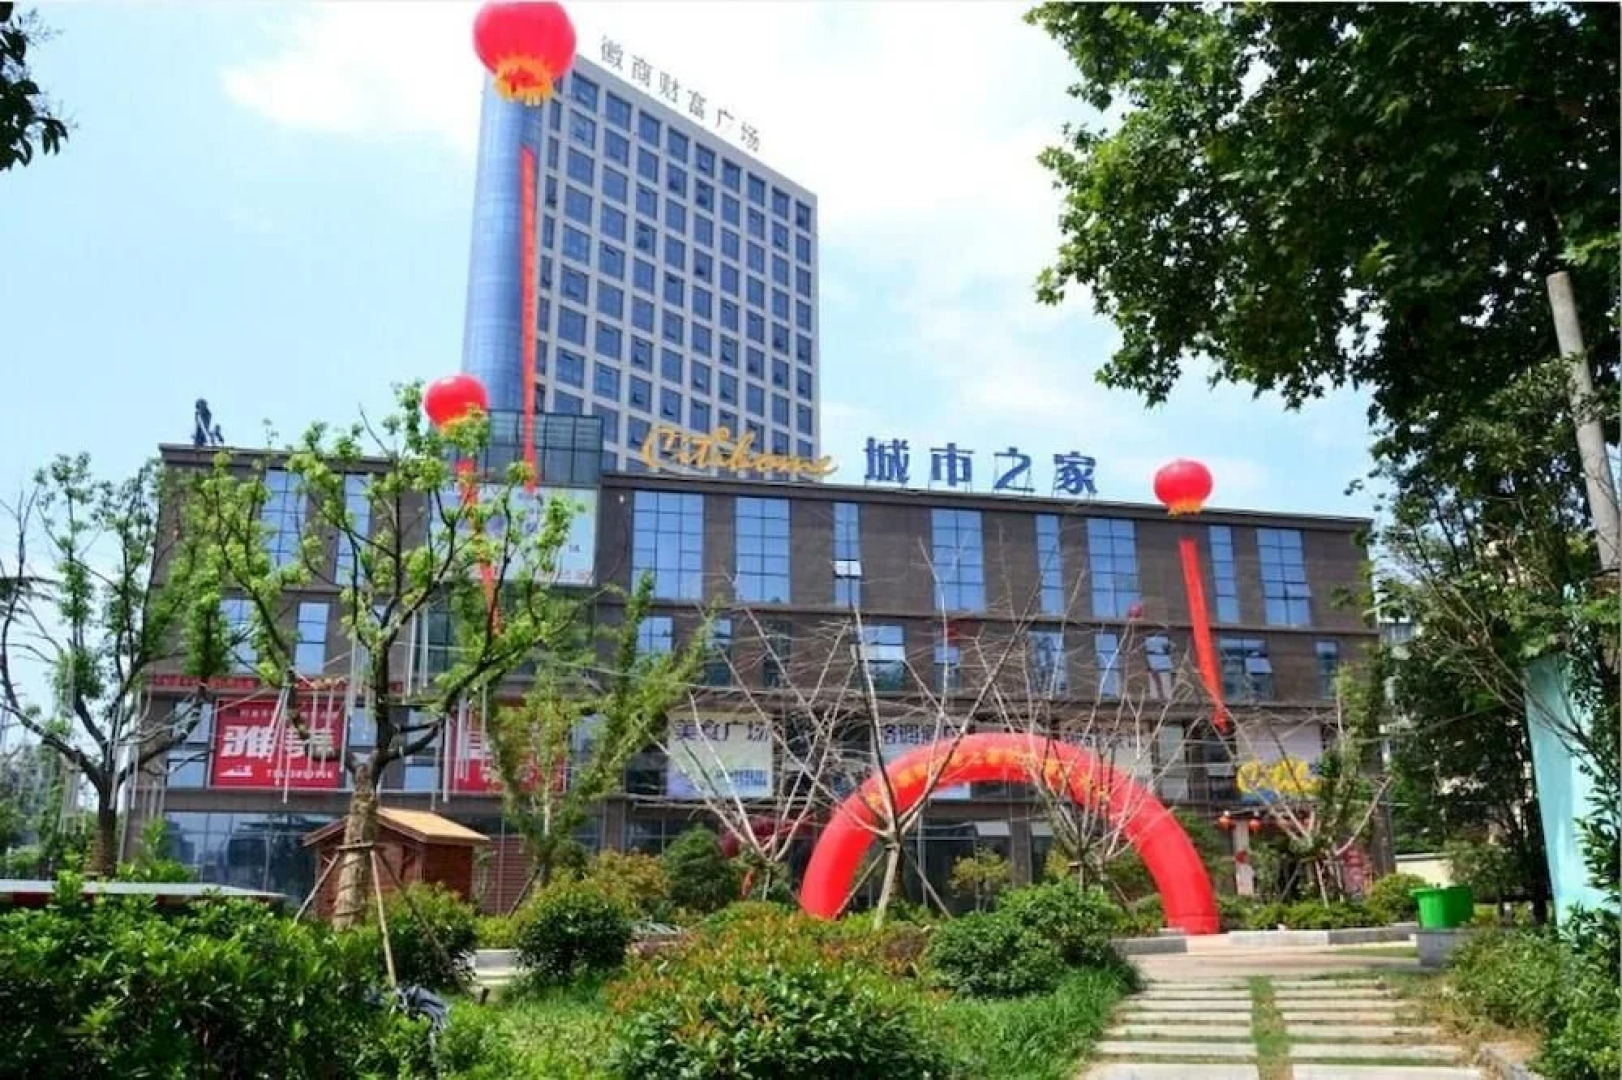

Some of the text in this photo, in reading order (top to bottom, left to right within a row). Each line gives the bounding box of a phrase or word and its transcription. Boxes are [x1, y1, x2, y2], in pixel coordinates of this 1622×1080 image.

[600, 34, 760, 152] 徽商财富广场
[863, 436, 1099, 494] 城市之家
